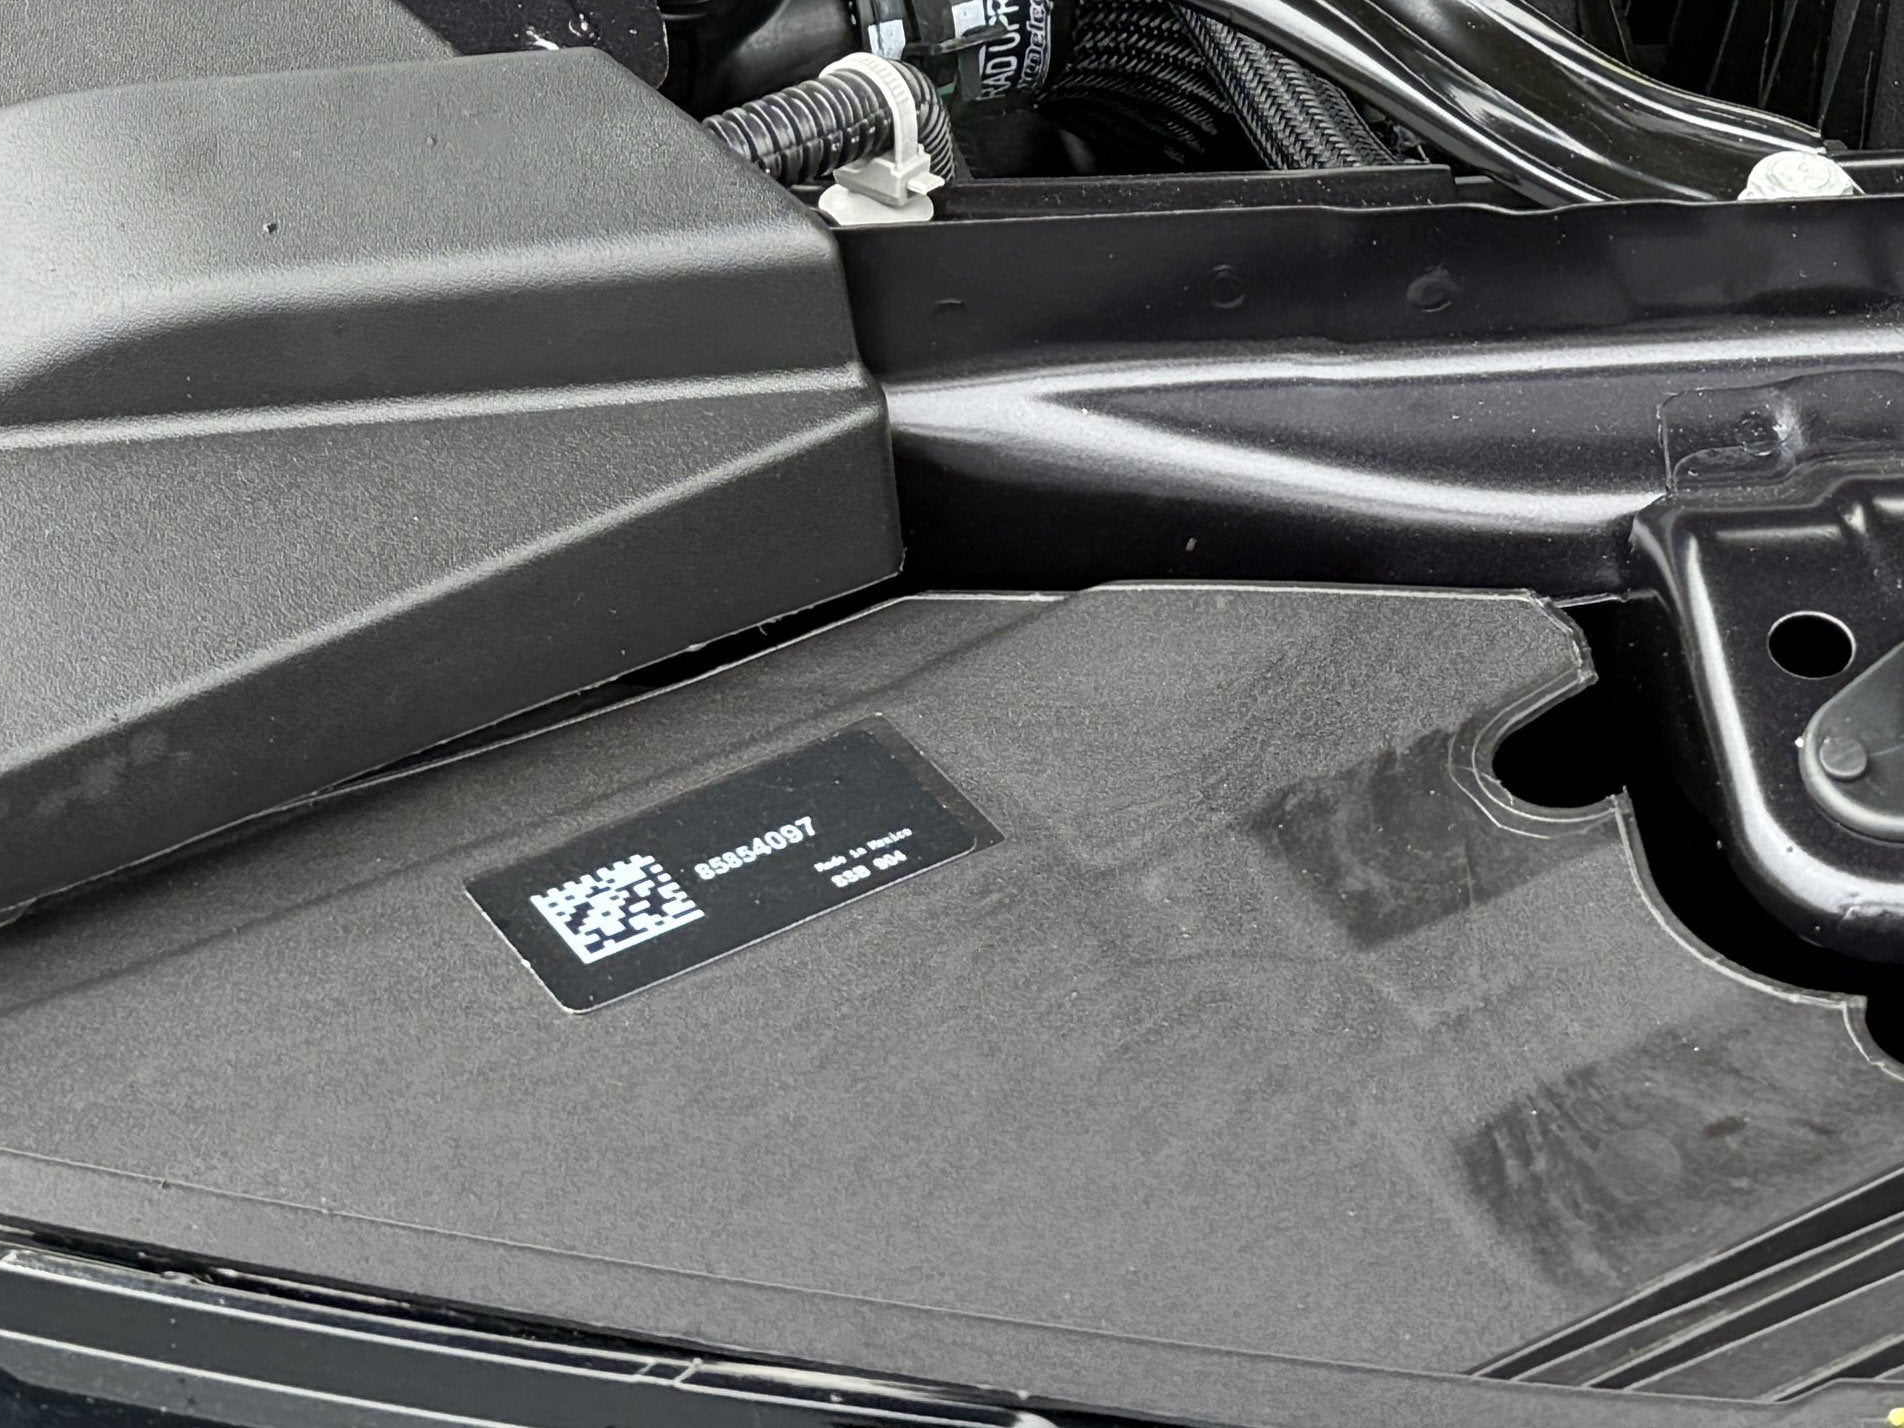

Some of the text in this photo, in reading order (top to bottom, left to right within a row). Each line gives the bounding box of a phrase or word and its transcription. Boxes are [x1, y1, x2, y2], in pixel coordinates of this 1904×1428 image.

[694, 815, 816, 881] 85854097
[814, 828, 913, 874] Made in Mexico
